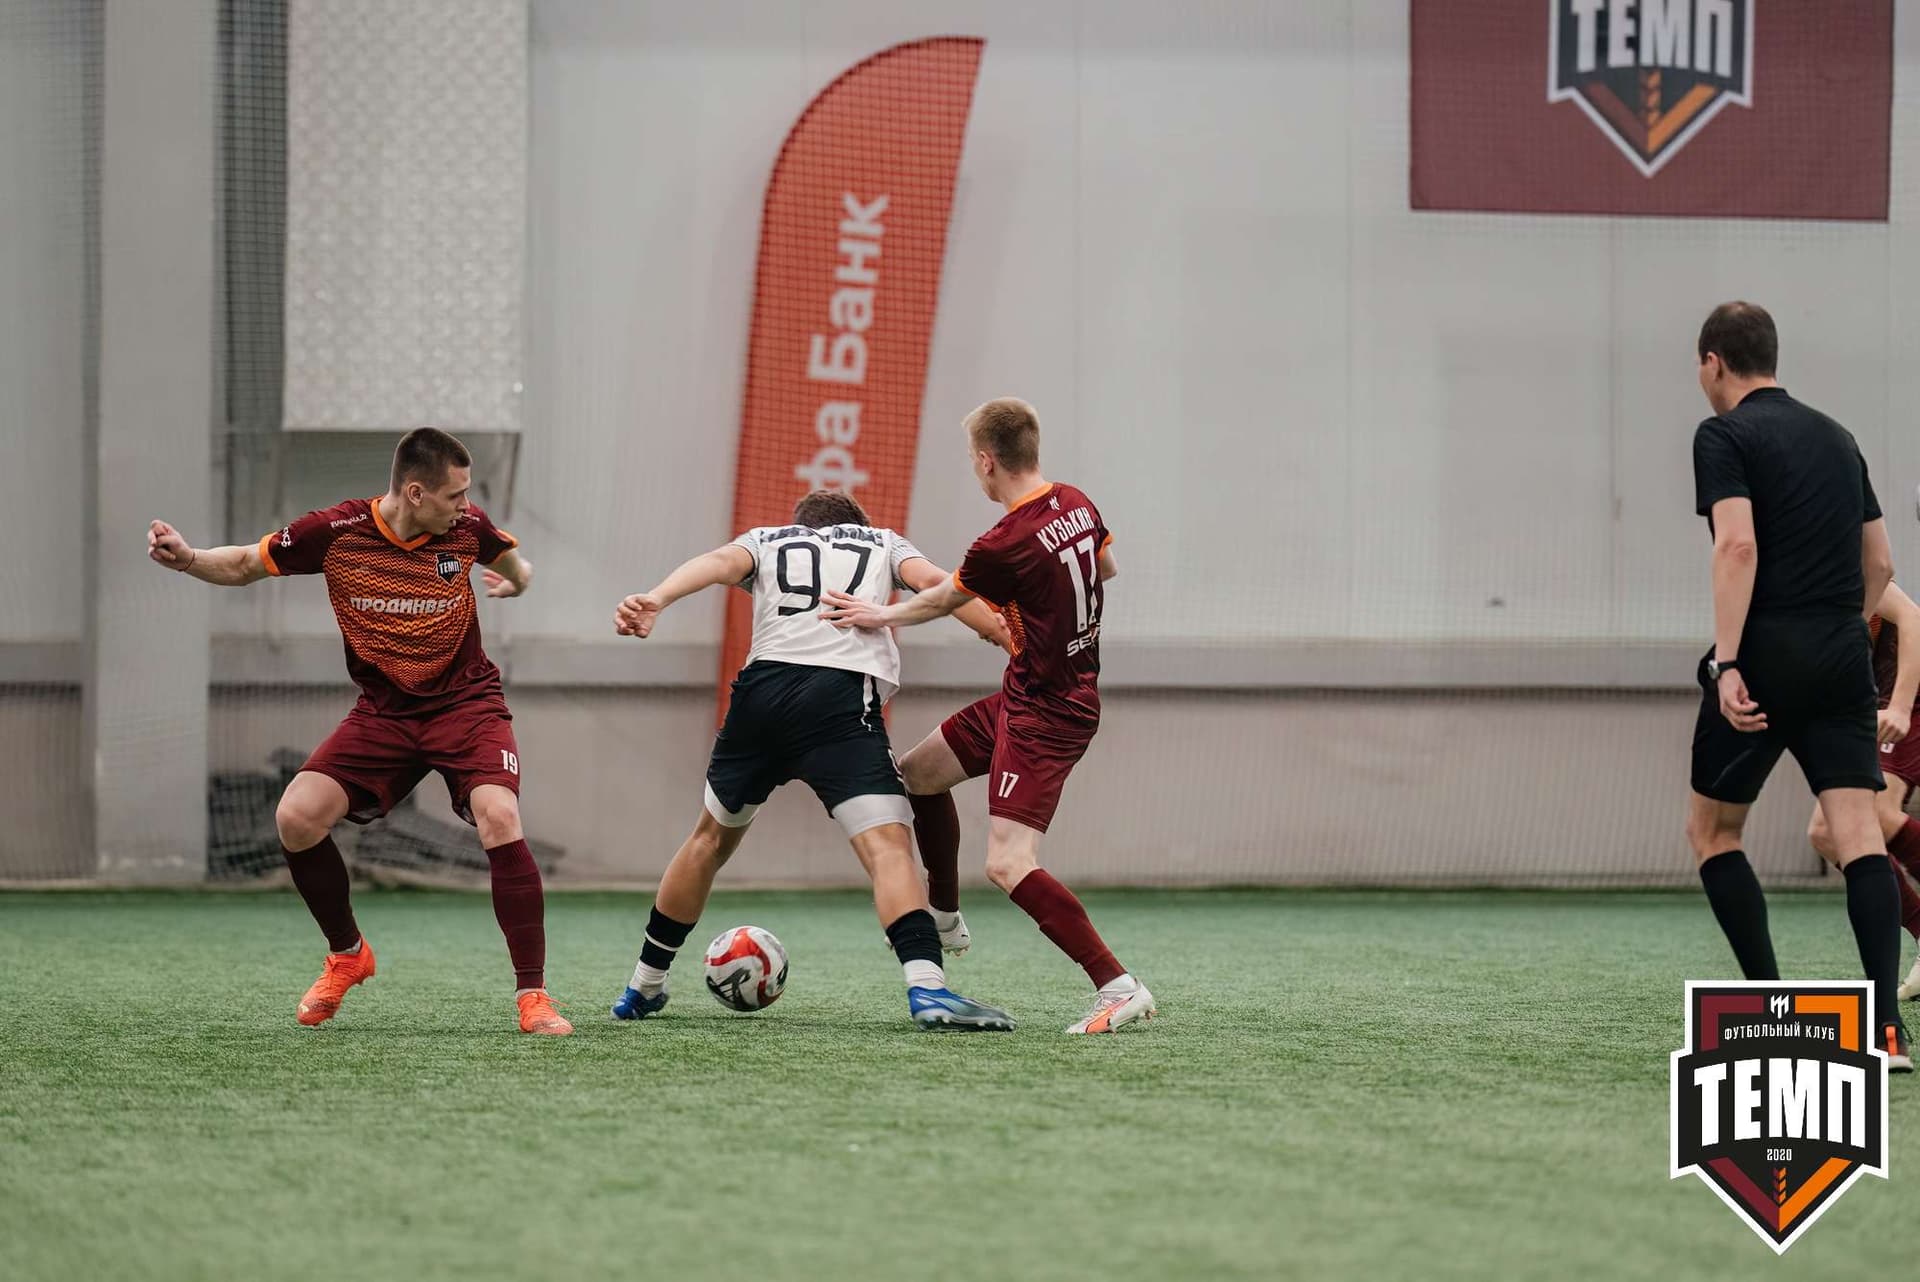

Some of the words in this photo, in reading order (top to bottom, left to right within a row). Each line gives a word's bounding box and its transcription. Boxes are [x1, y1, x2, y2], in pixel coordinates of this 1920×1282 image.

[1571, 0, 1734, 77] ТЕМП
[807, 192, 889, 385] Банк
[1036, 506, 1095, 553] КУЗЬКИН
[438, 560, 461, 575] ТЕМП
[777, 541, 873, 620] 97
[1058, 535, 1098, 633] 17
[500, 749, 518, 775] 19
[998, 771, 1019, 798] 17
